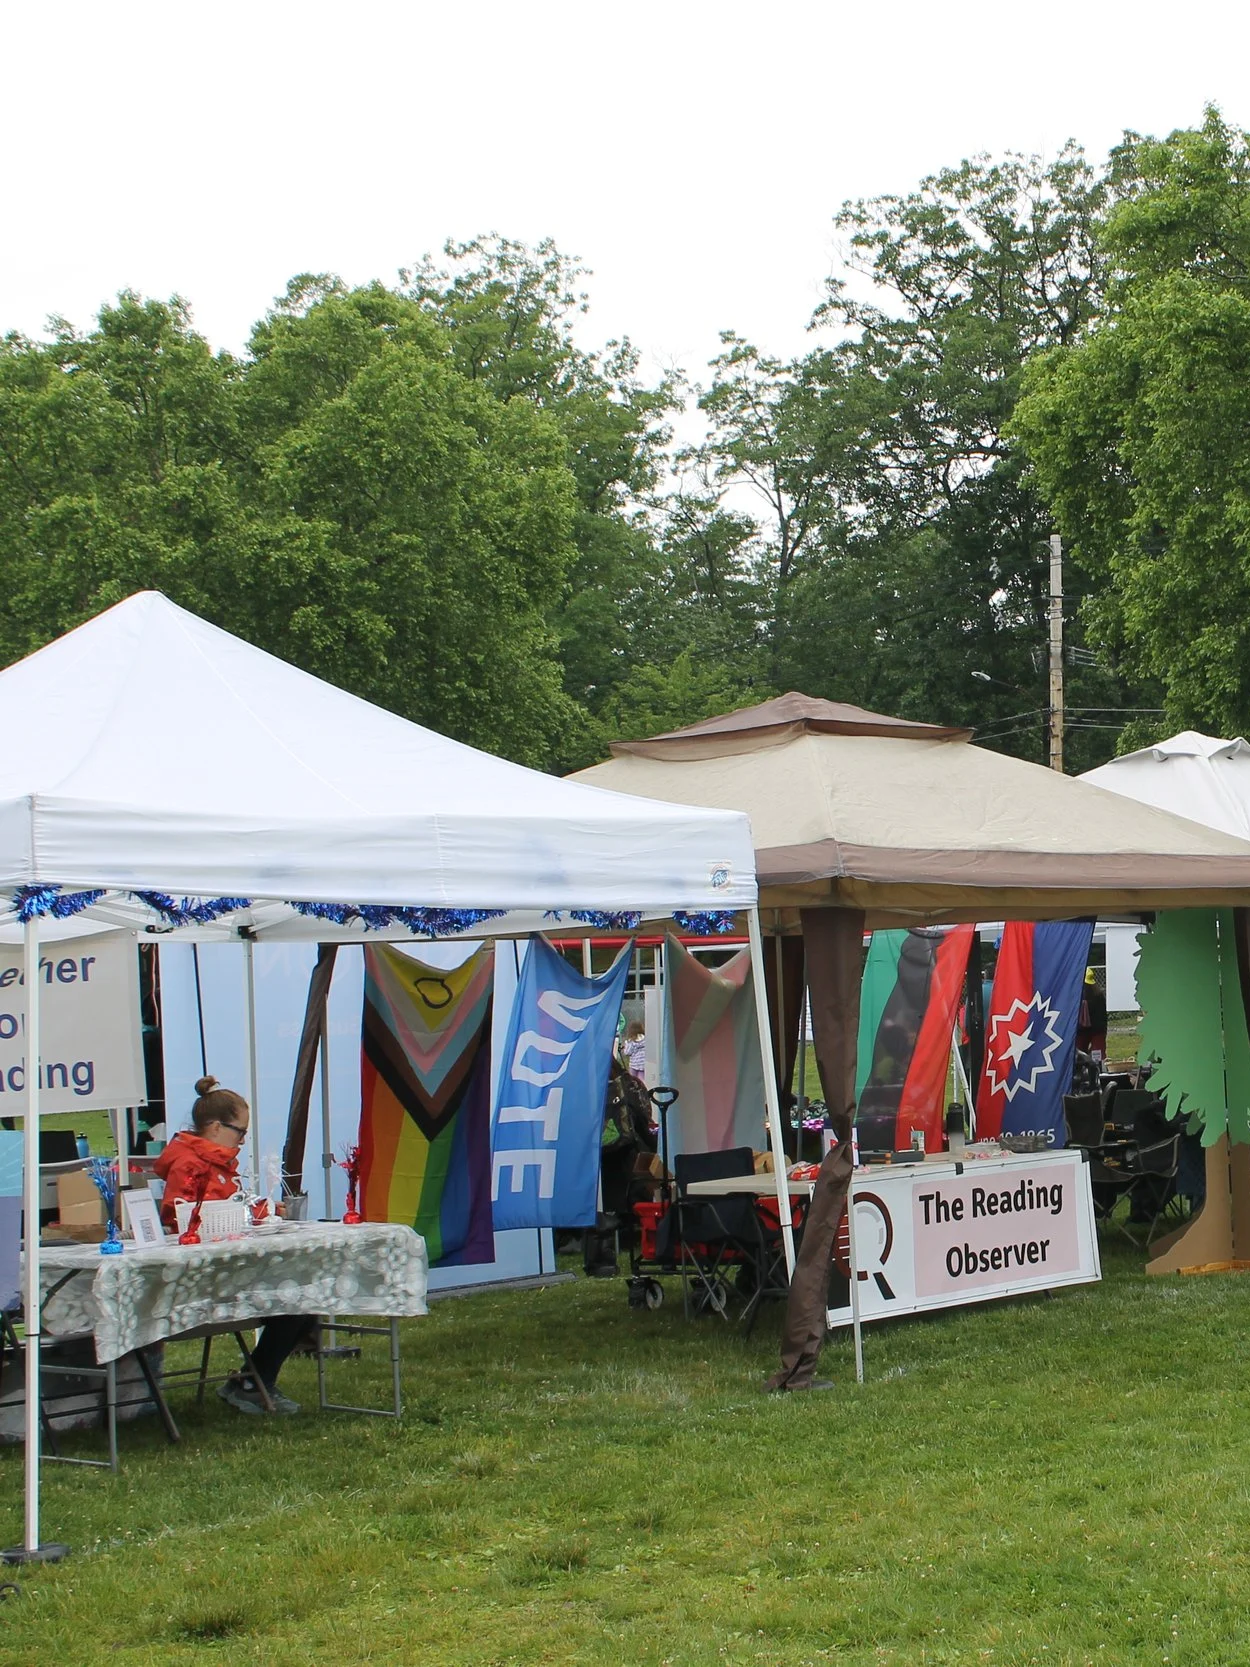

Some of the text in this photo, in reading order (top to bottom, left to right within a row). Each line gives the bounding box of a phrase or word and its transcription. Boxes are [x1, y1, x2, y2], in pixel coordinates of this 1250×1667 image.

[0, 957, 96, 988] eher
[0, 1056, 95, 1096] ding
[918, 1180, 1063, 1225] The Reading
[946, 1239, 1050, 1278] Observer
